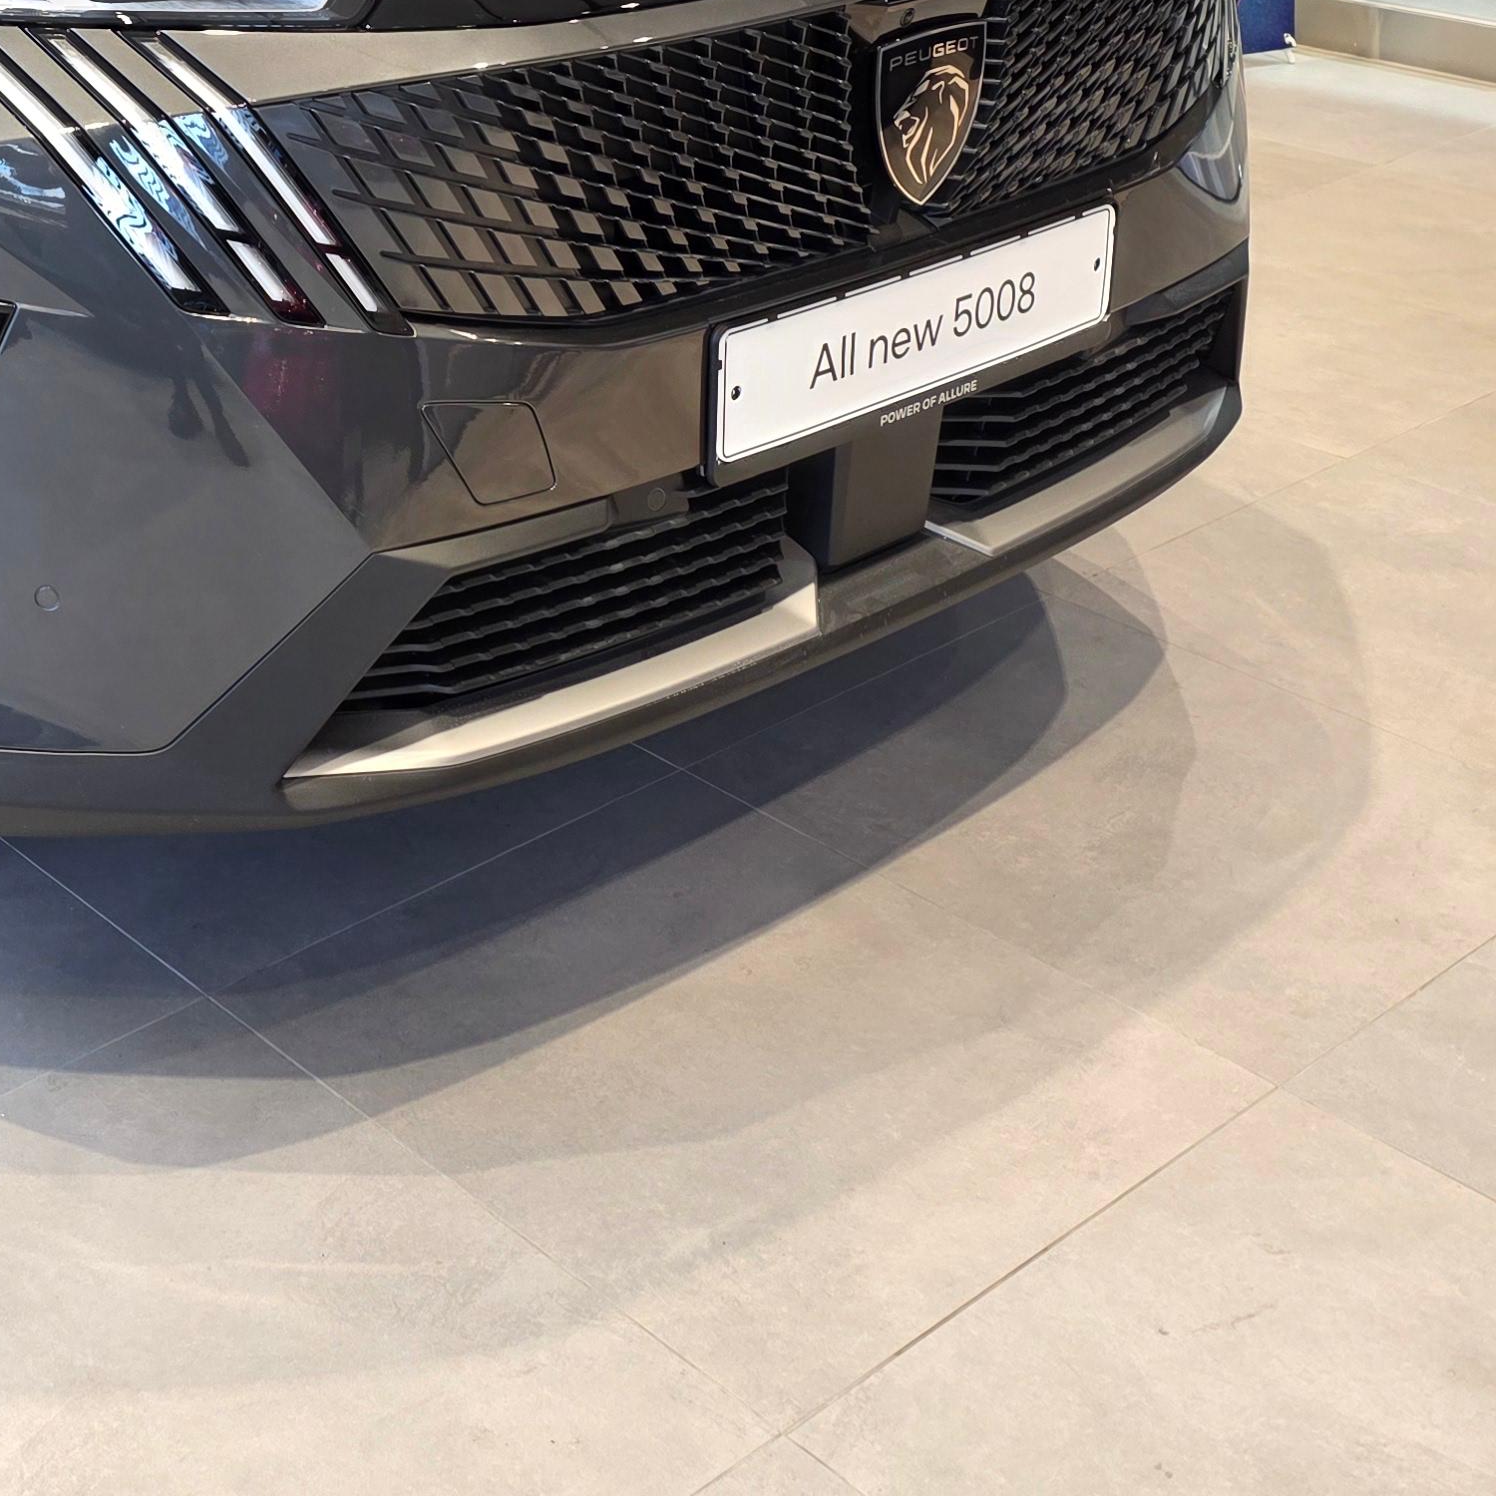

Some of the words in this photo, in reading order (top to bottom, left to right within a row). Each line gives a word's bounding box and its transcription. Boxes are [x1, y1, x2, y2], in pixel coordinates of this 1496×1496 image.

[889, 35, 979, 72] PEUGEOT
[809, 330, 857, 390] All
[867, 312, 945, 368] new
[953, 271, 1036, 339] 5008
[880, 402, 921, 427] POWER
[922, 395, 937, 410] OF
[938, 379, 978, 405] ALLURE
